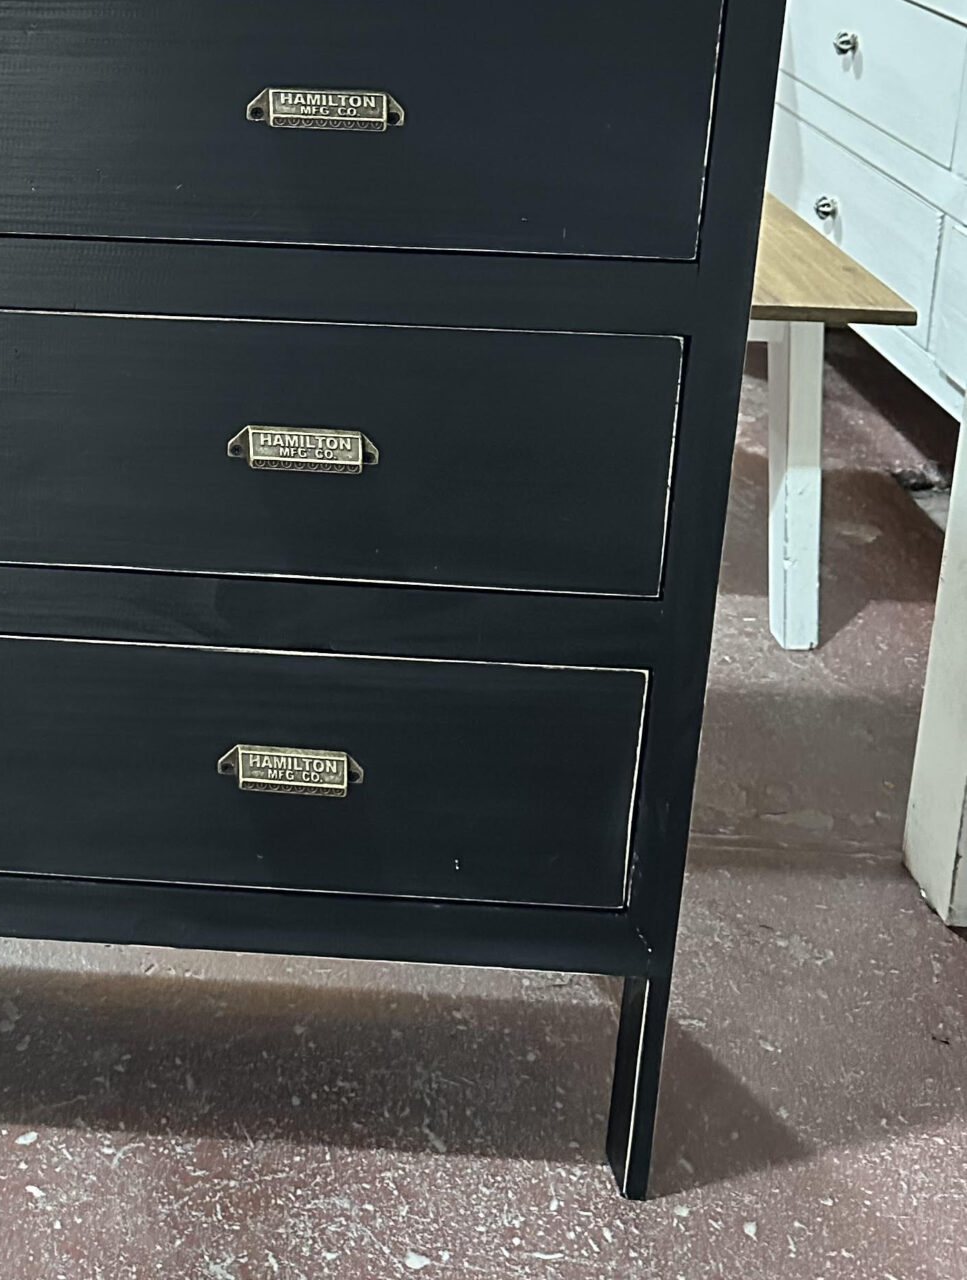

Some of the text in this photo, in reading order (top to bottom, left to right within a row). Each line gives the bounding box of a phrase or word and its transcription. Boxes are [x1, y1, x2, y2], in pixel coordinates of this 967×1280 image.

[280, 92, 376, 108] HAMILTON
[300, 106, 330, 116] MFG
[260, 433, 352, 450] HAMILTON
[279, 447, 307, 458] MFG
[249, 754, 337, 773] HAMILTON
[267, 769, 295, 781] MFG
